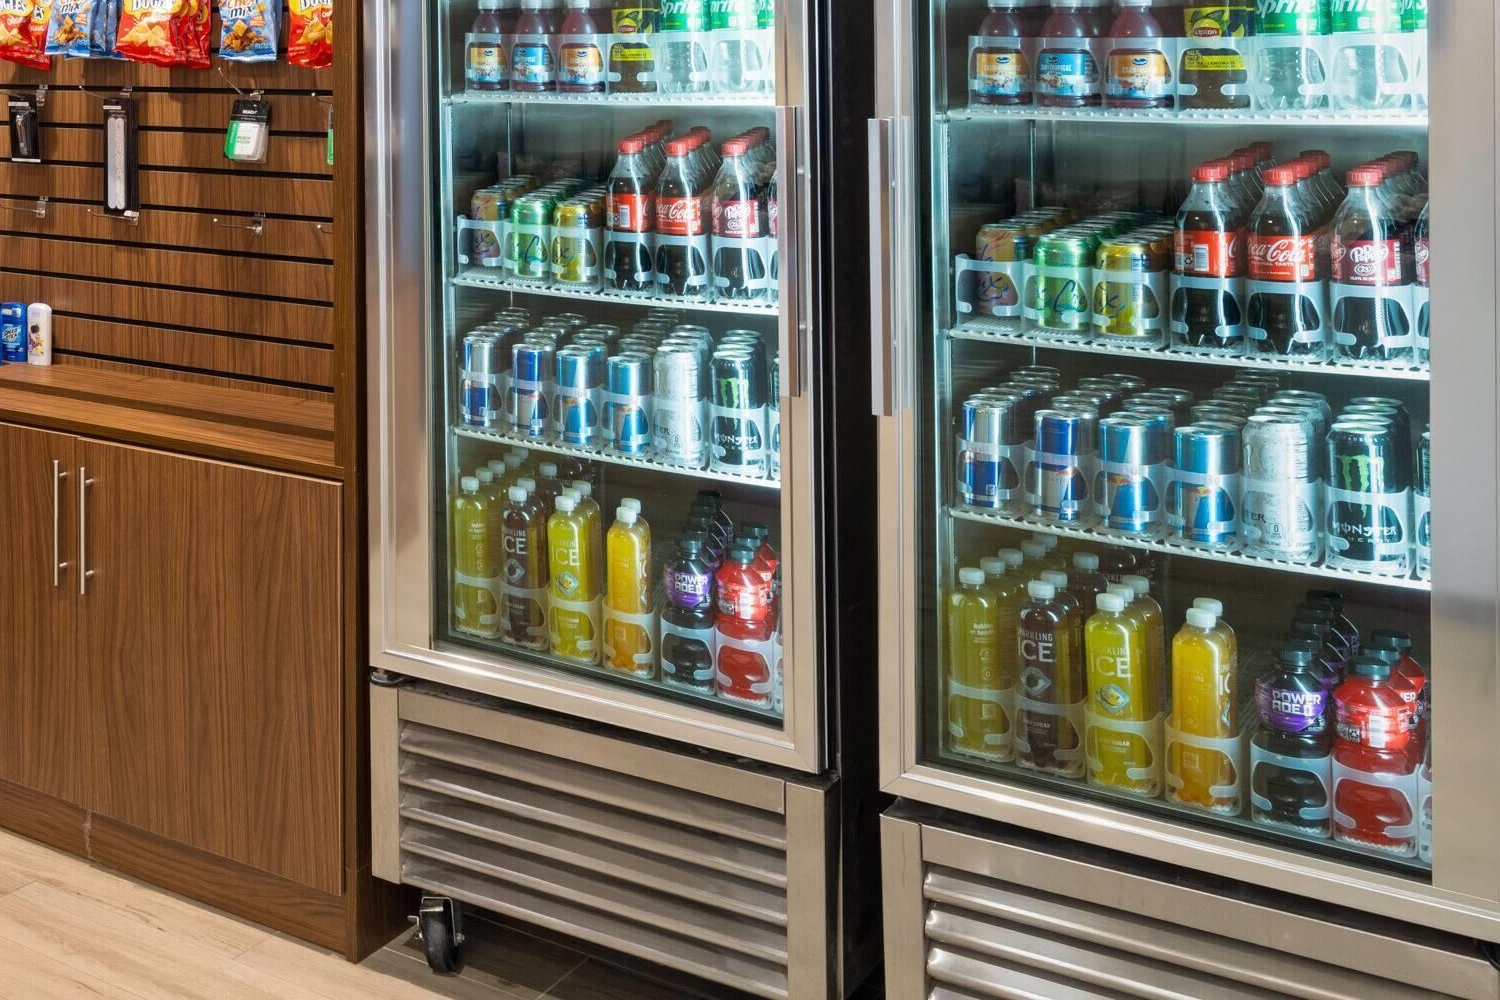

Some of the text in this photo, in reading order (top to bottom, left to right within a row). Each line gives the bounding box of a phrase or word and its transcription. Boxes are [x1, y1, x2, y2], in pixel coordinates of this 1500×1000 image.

[61, 2, 82, 14] mix
[230, 5, 254, 19] mix
[1194, 28, 1218, 36] Lipton
[1332, 521, 1398, 537] MONSTER
[675, 573, 708, 585] POWER
[1017, 636, 1055, 663] ICE
[1091, 652, 1133, 678] ICE
[1271, 689, 1322, 706] POWER
